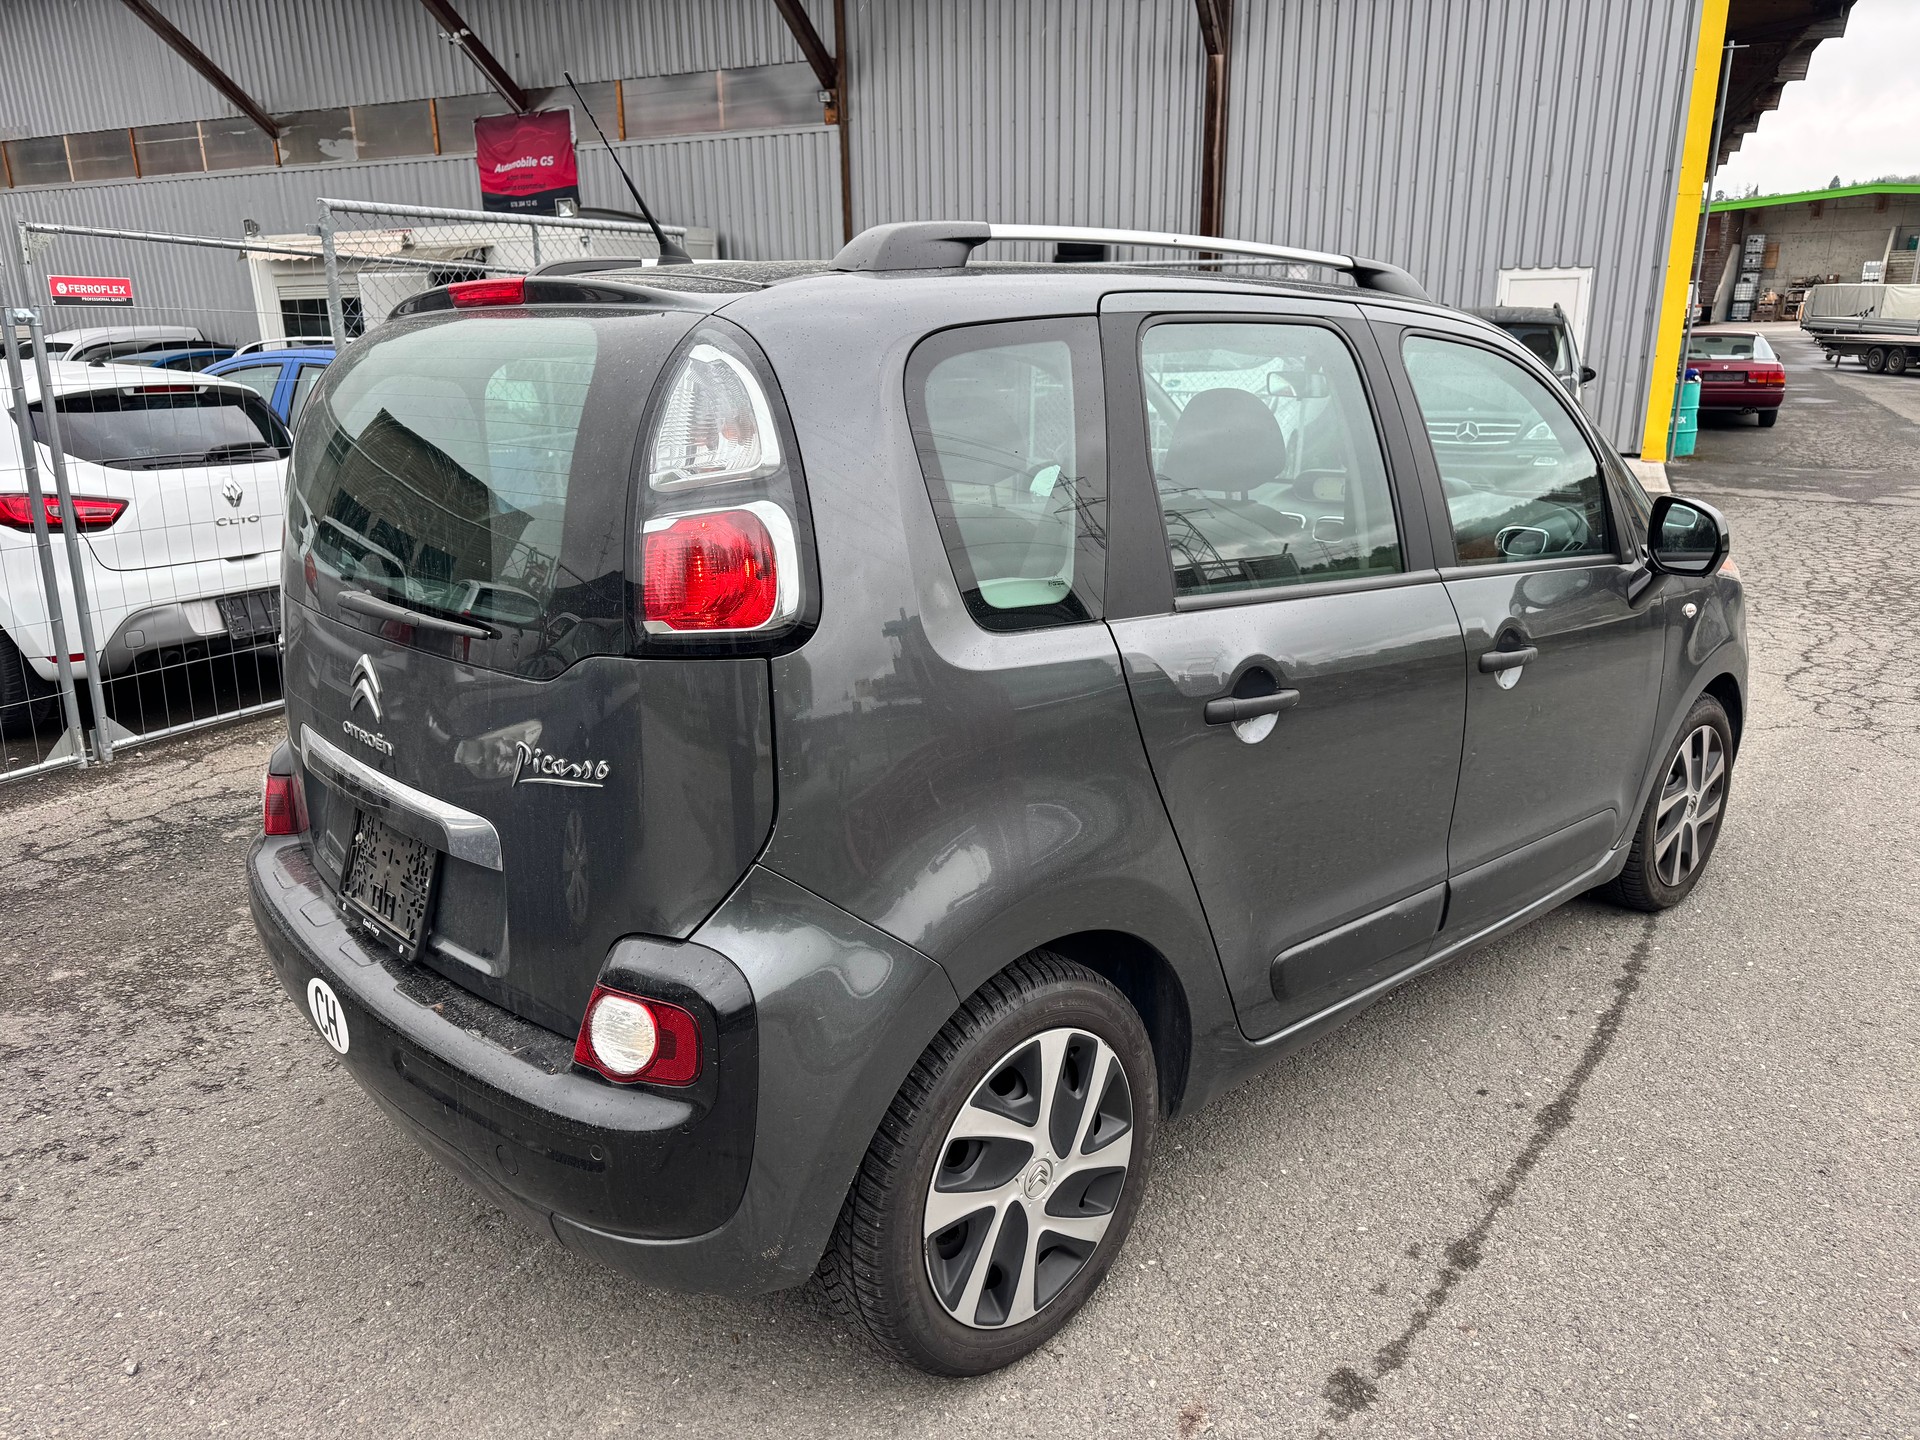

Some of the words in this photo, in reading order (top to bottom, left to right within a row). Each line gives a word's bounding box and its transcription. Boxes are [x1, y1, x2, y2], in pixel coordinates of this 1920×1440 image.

[494, 157, 538, 173] Automobile
[540, 156, 554, 166] GS
[68, 284, 126, 294] FERROFLEX
[216, 515, 260, 527] CLIO
[512, 741, 611, 788] Picasso
[315, 985, 342, 1049] CH
